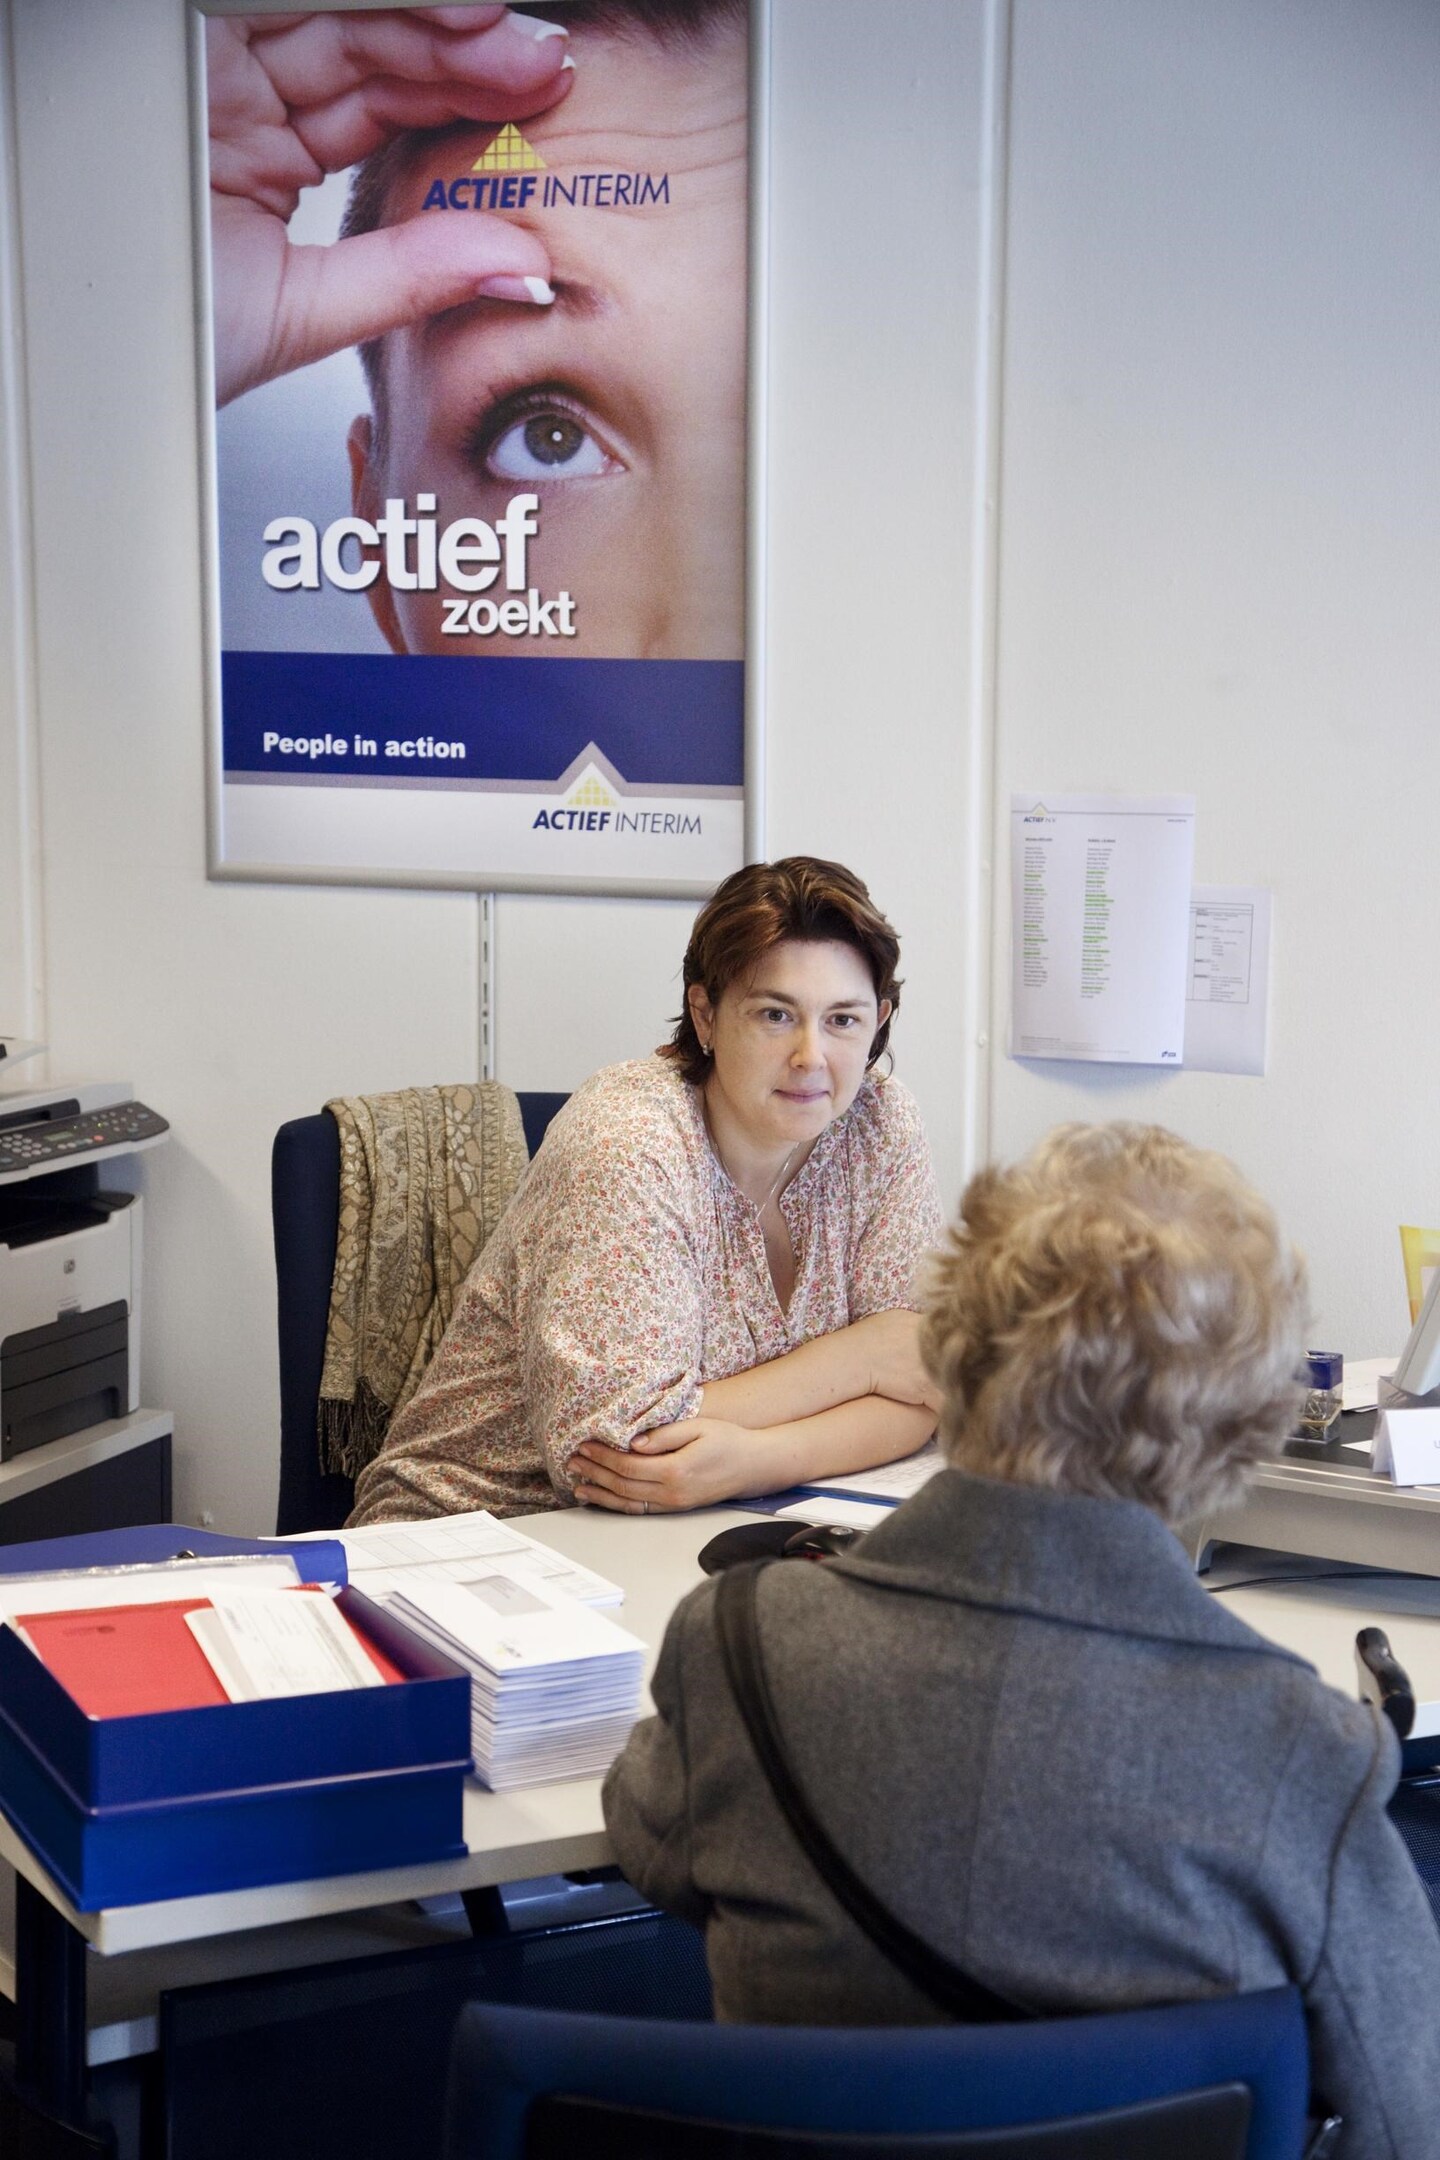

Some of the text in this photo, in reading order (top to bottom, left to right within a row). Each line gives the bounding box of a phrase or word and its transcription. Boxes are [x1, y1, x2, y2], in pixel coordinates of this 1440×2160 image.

[421, 172, 670, 210] ACTIEF INTERIM
[261, 493, 539, 592] actief
[441, 588, 576, 636] zoekt
[263, 731, 466, 759] People in action
[532, 809, 702, 835] ACTIEF INTERIM
